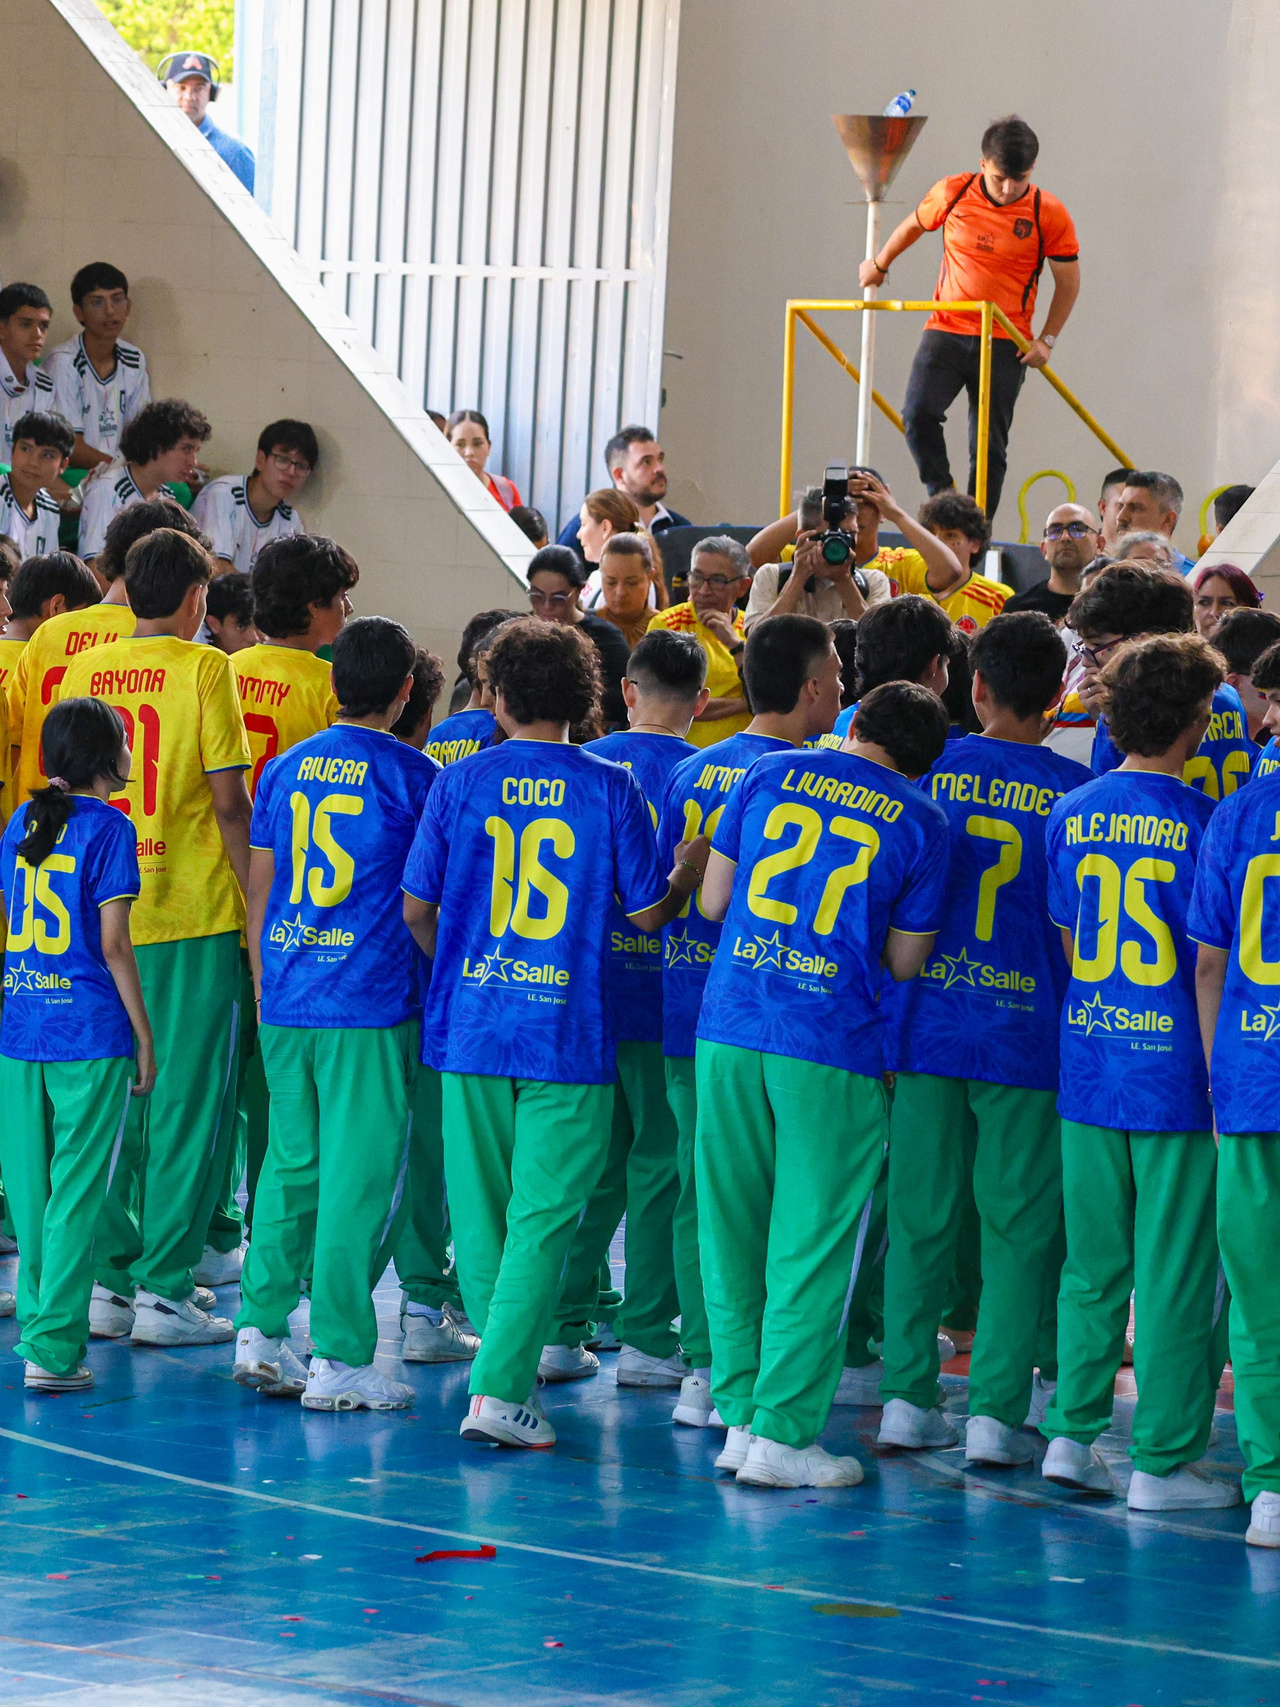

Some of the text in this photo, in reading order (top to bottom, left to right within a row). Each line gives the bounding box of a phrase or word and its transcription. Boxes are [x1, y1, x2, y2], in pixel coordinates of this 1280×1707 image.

[89, 668, 167, 697] BAYONA
[296, 756, 369, 786] RIVERA
[502, 777, 566, 807] COCO
[780, 769, 904, 823] LIVARDINO
[136, 838, 167, 857] alle
[1065, 812, 1189, 852] ALEJANDRO
[289, 790, 364, 908] 15
[484, 815, 576, 941] 16
[747, 802, 880, 936] 27
[965, 814, 1023, 942] 7
[6, 853, 76, 956] 05
[1071, 853, 1177, 987] 05
[269, 922, 355, 947] La Salle
[611, 931, 662, 954] Salle
[462, 957, 570, 987] La Salle
[732, 936, 758, 960] La
[785, 949, 839, 978] Salle
[3, 971, 72, 990] a Salle
[919, 959, 1036, 993] La Salle
[1068, 1004, 1174, 1034] La Salle
[1240, 1010, 1267, 1032] La
